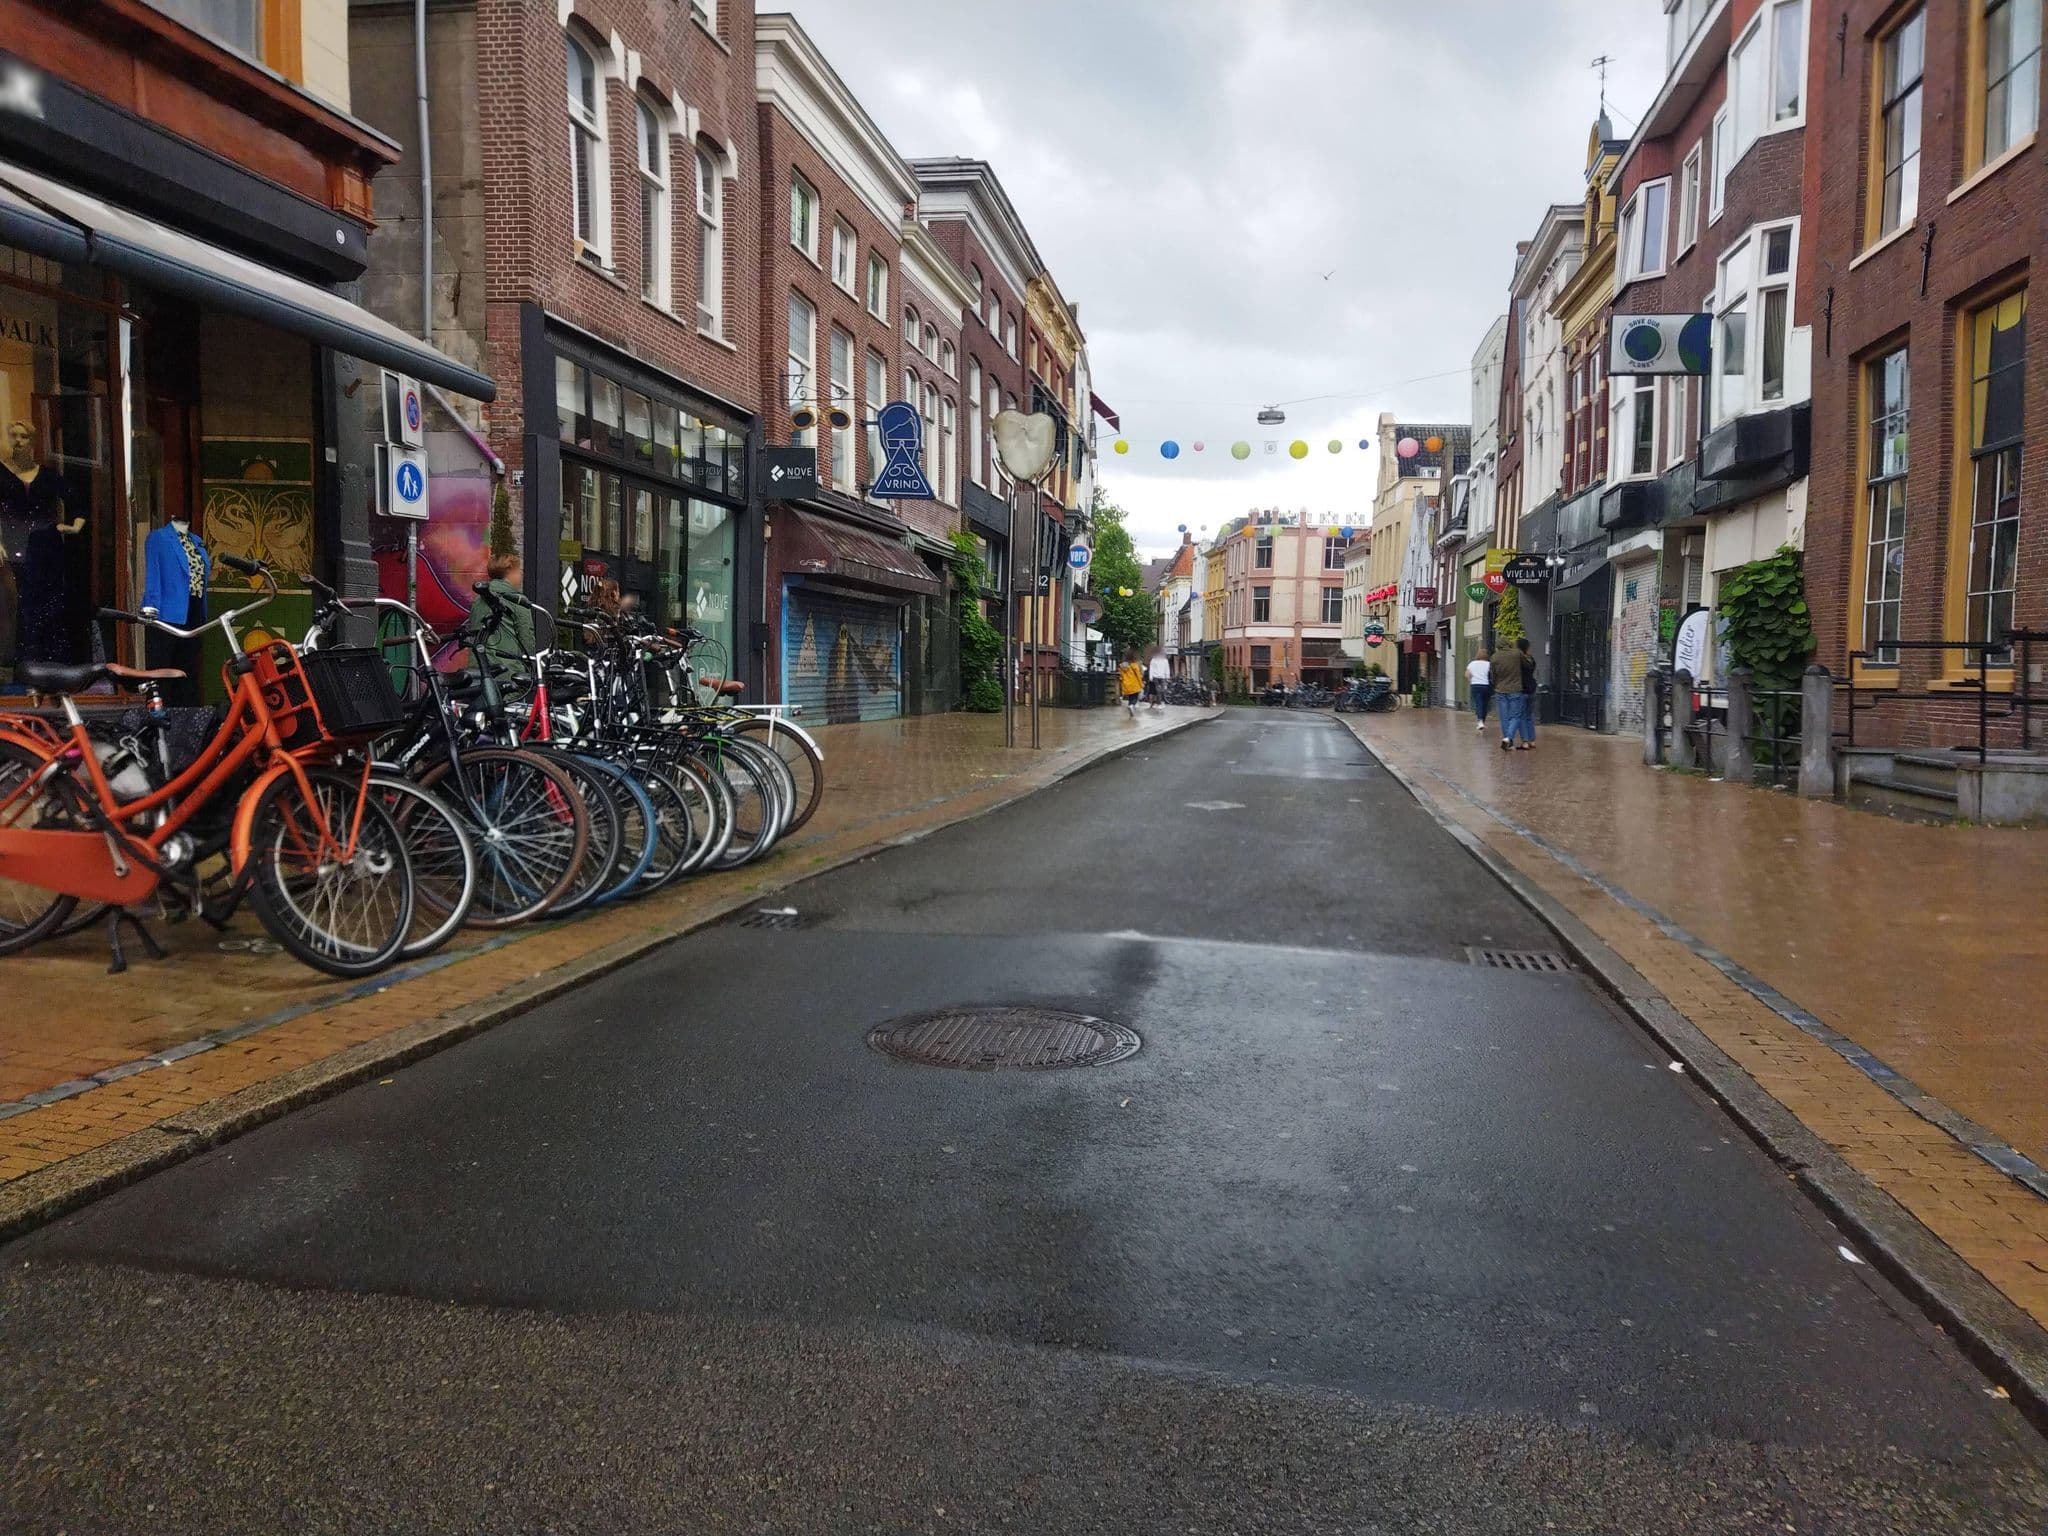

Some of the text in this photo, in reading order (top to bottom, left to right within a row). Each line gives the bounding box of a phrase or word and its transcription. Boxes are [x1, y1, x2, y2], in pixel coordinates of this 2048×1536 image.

[1628, 318, 1661, 329] SAVE OUR
[787, 466, 813, 477] NOVE
[884, 479, 920, 490] VRIND
[1070, 550, 1088, 563] vera
[1506, 569, 1550, 578] VIVE LA VIE
[1471, 587, 1486, 595] MF
[708, 592, 729, 610] NOVE
[1678, 623, 1696, 670] Atelier
